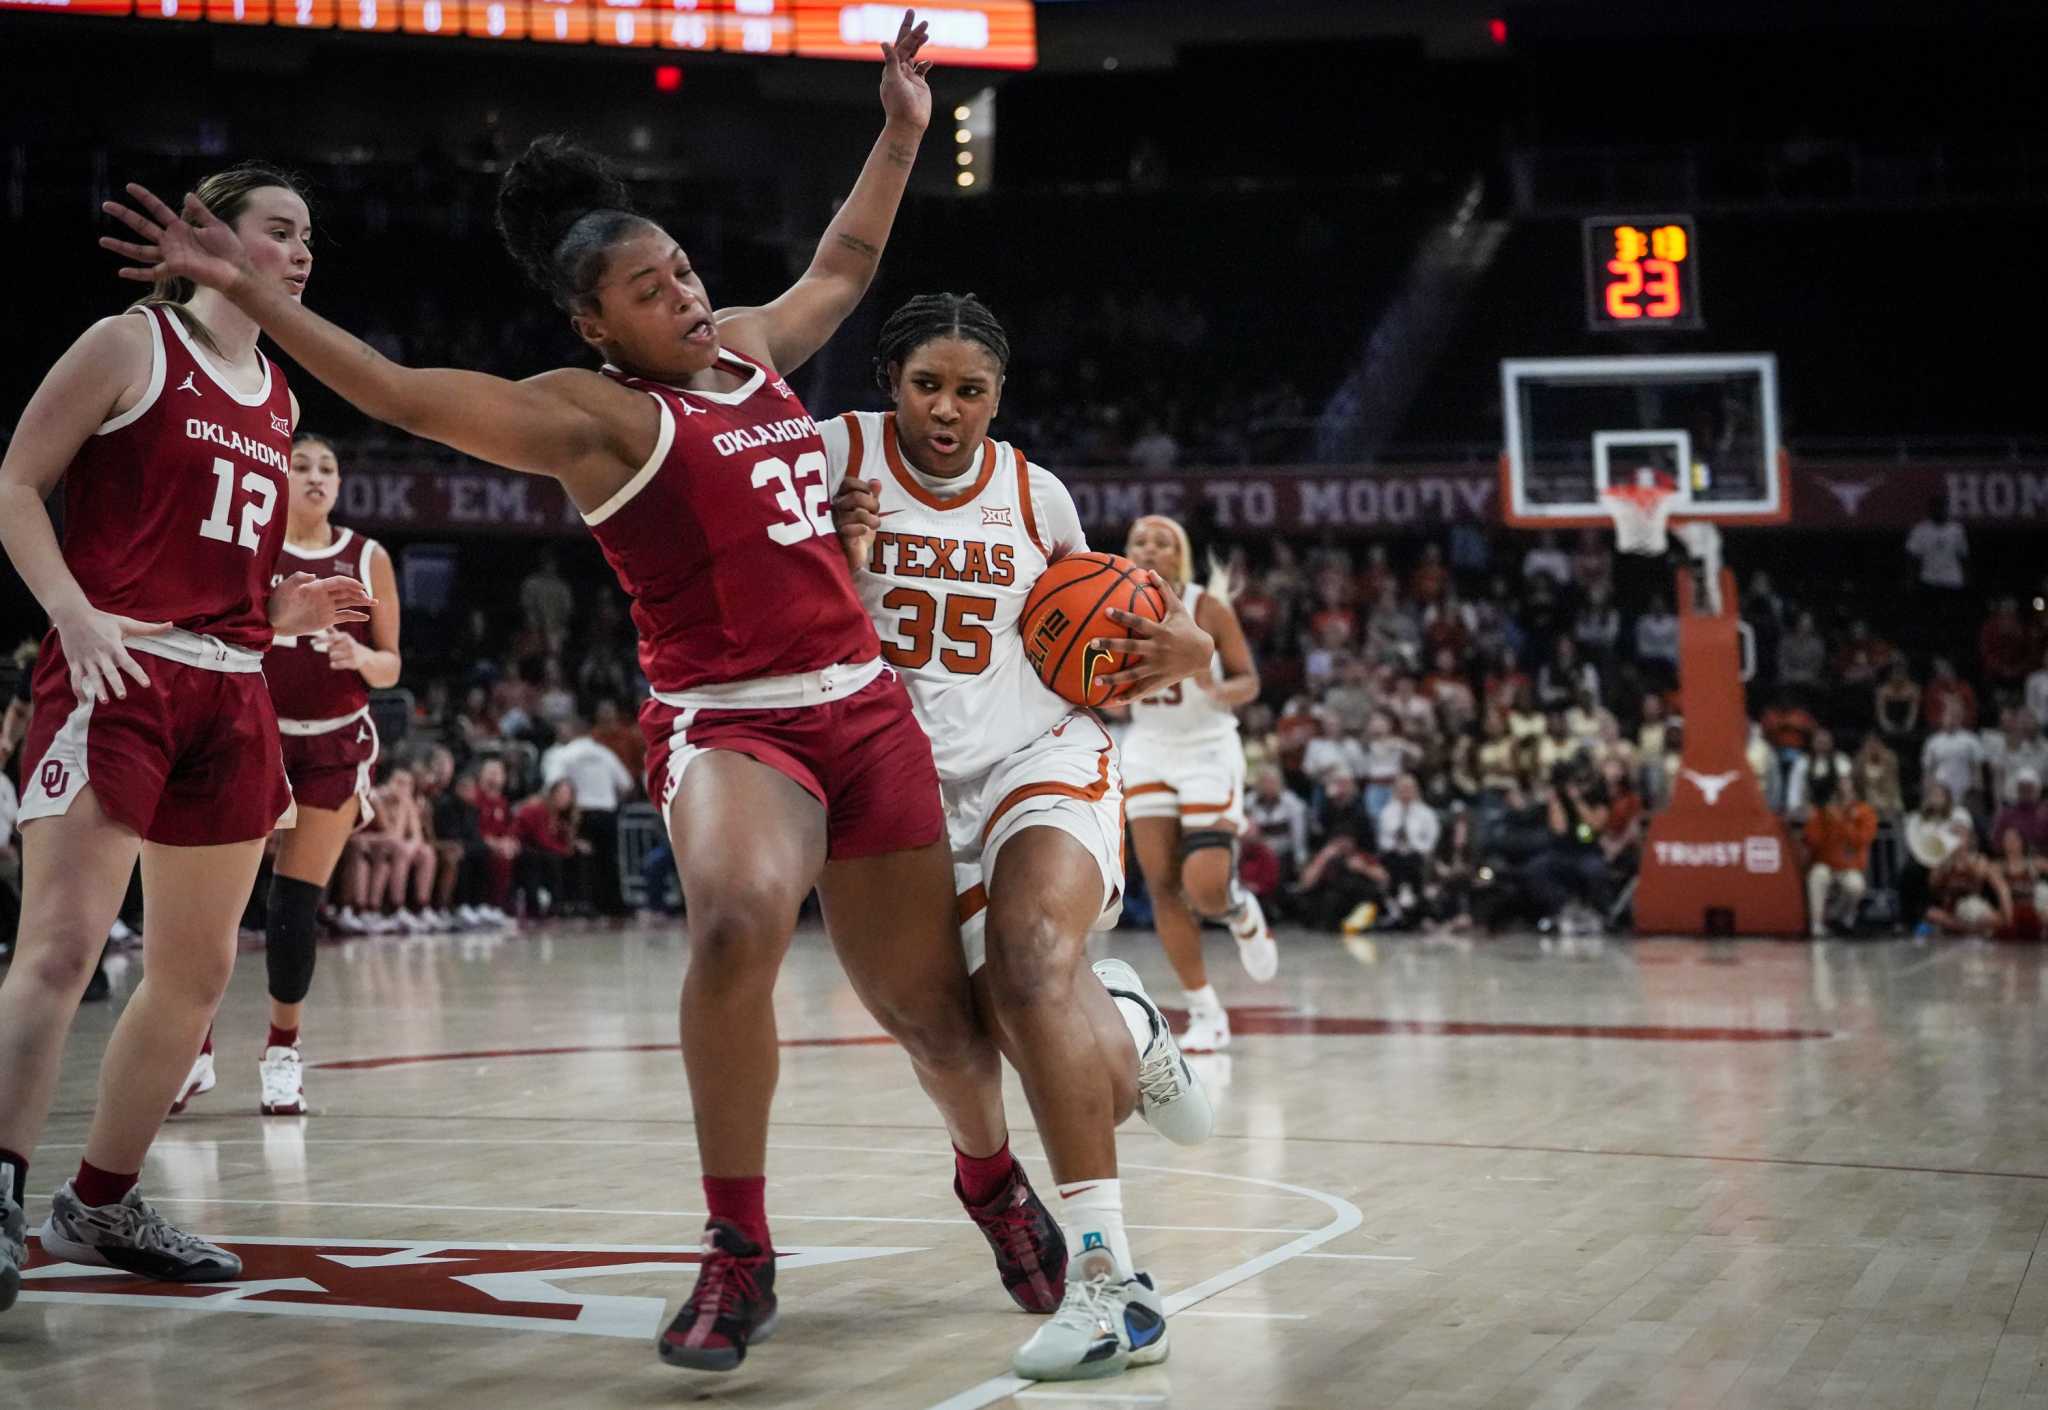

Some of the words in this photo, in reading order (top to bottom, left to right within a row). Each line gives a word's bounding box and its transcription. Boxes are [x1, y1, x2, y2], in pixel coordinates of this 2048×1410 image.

[1606, 260, 1680, 318] 23
[186, 418, 288, 477] OKLAHOMA
[712, 415, 819, 456] OKLAHOM
[200, 457, 277, 556] 12
[751, 451, 836, 546] 32
[1206, 480, 1276, 524] TO
[870, 531, 1015, 586] TEXAS
[880, 587, 997, 676] 35
[41, 760, 70, 798] OU
